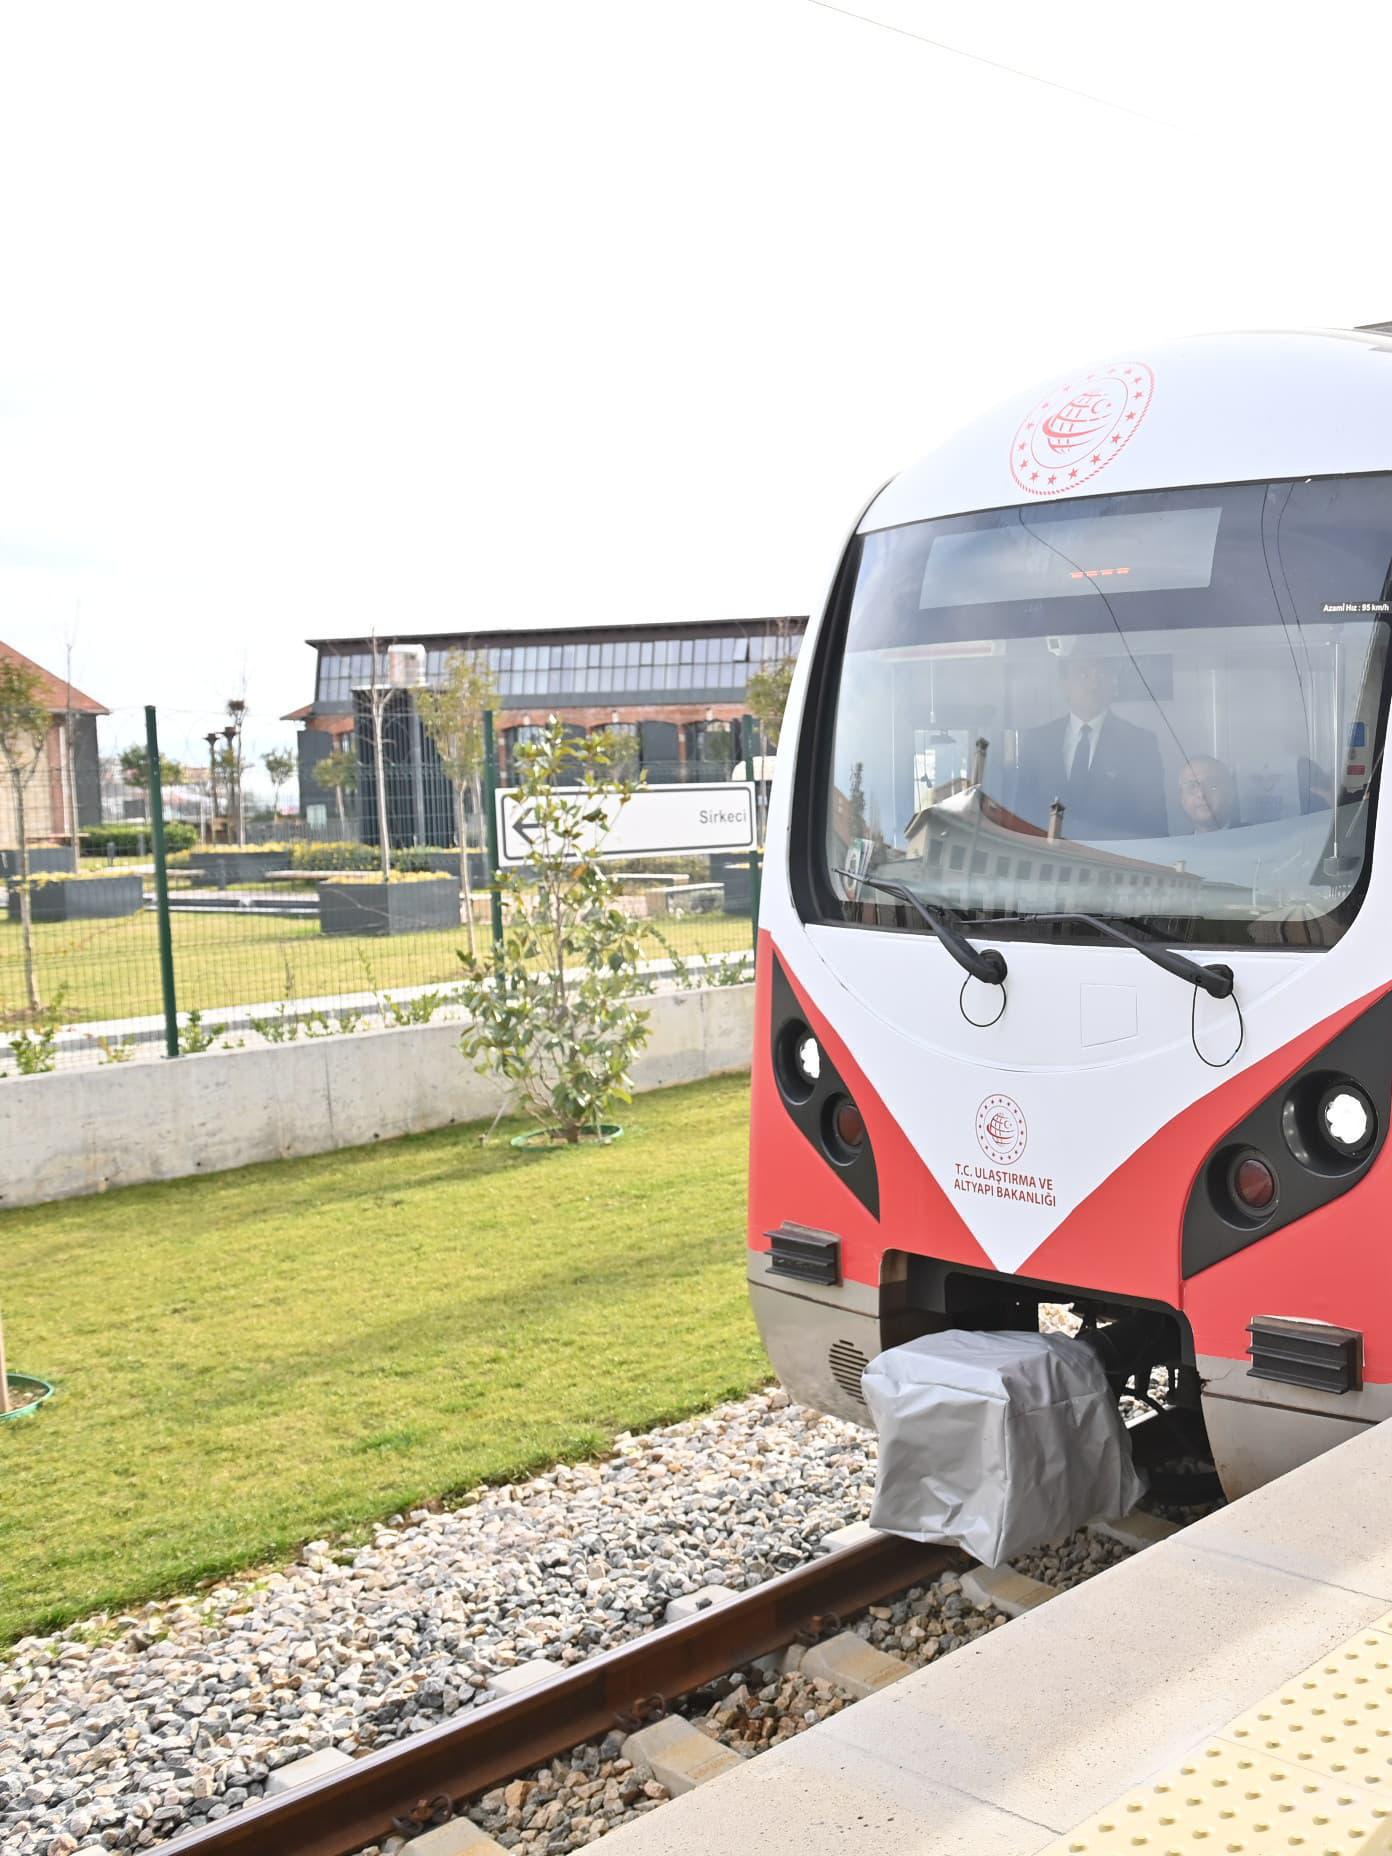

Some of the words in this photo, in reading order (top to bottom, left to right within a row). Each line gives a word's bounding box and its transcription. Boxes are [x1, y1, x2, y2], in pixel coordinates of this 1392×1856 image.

[1362, 603, 1371, 612] 95
[1371, 603, 1390, 612] km/h
[699, 808, 747, 825] Sirkeci
[954, 1163, 973, 1177] T.C.
[974, 1166, 1037, 1188] ULAŞTIRMA
[1039, 1177, 1053, 1191] VE
[954, 1178, 994, 1196] ALTYAPI
[996, 1186, 1056, 1207] BAKANLIĞI
